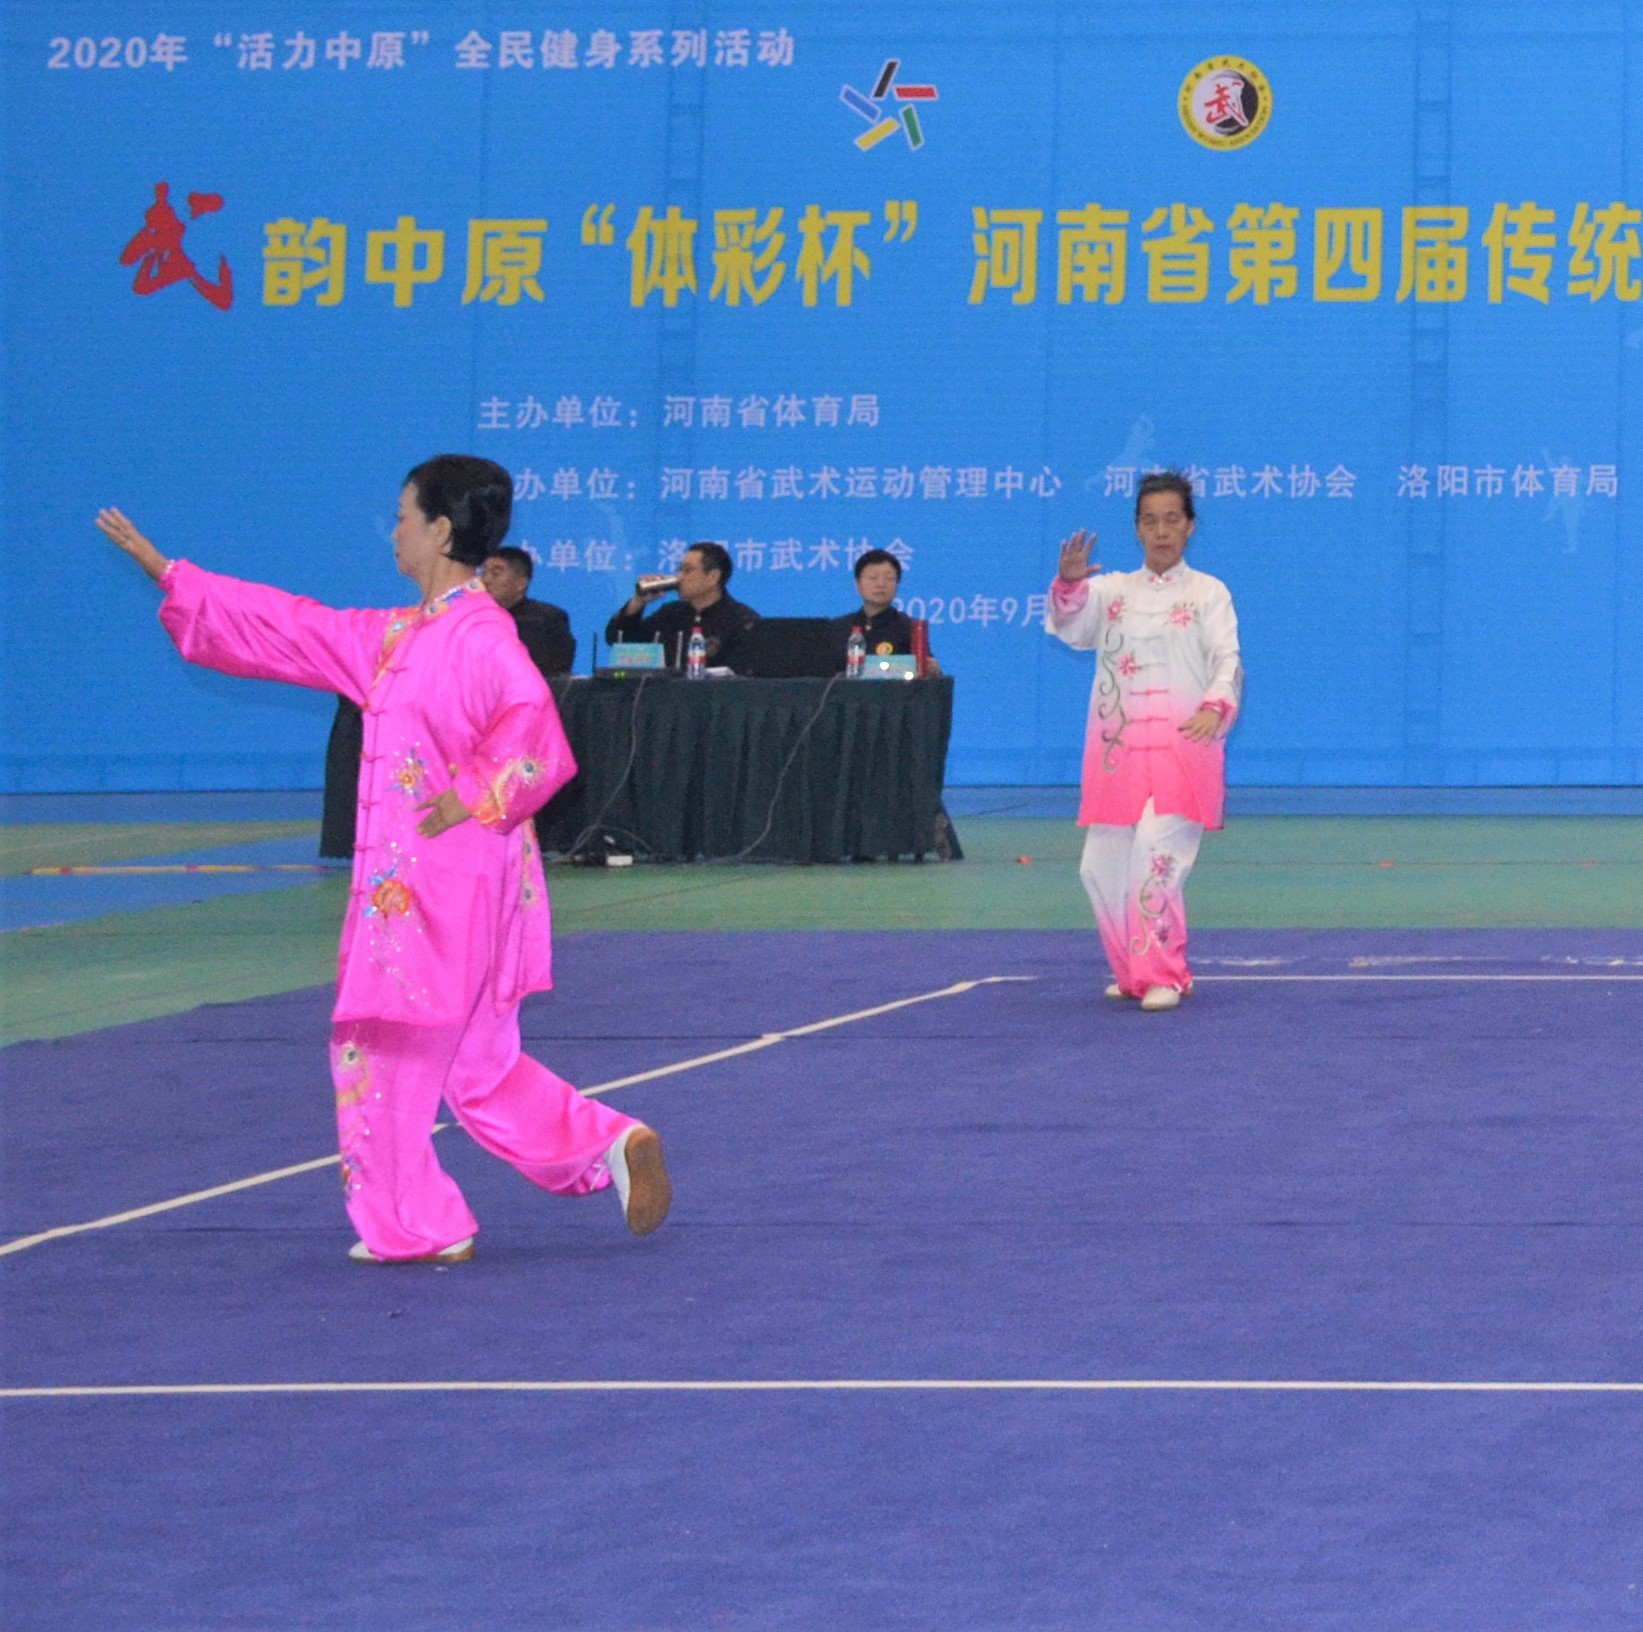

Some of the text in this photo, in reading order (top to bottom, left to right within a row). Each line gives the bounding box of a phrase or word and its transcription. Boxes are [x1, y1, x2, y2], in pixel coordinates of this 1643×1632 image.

[513, 466, 1062, 501] 办单位：河南省武术运动管理中心
[1397, 464, 1618, 498] 洛阳市体育局
